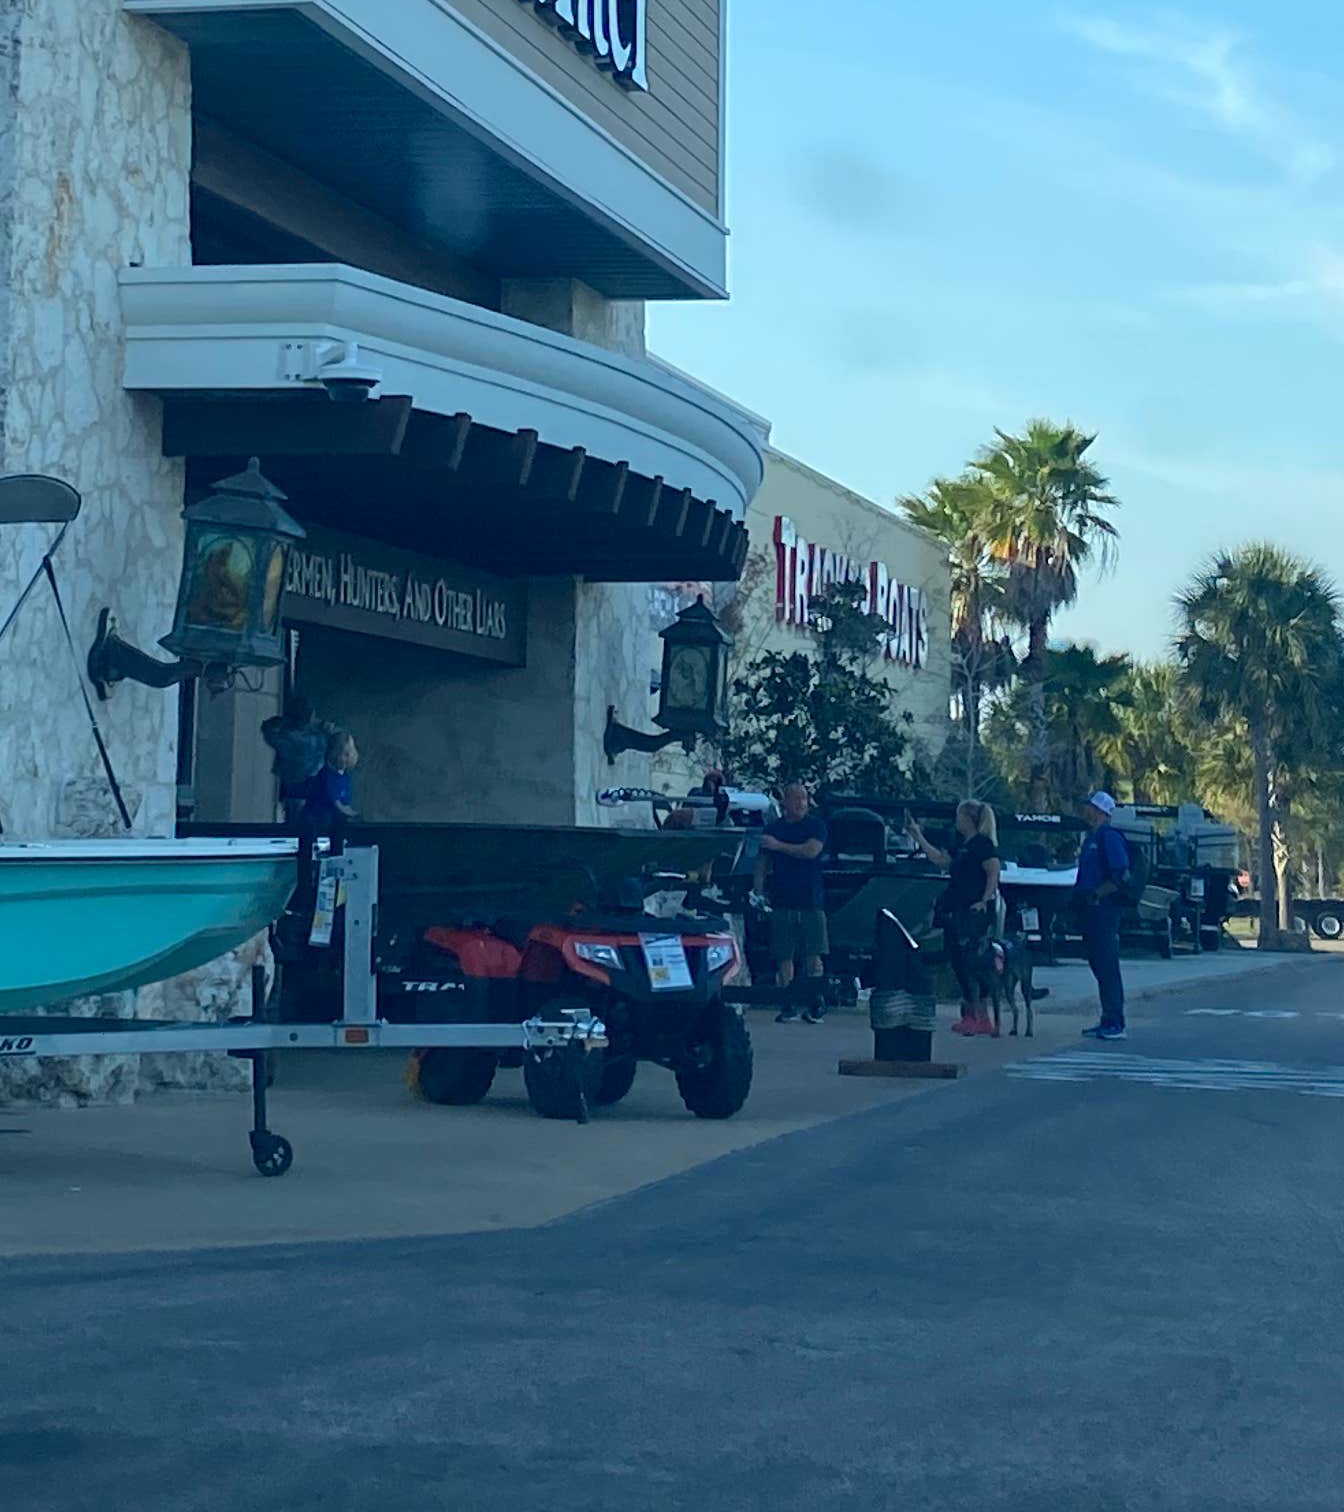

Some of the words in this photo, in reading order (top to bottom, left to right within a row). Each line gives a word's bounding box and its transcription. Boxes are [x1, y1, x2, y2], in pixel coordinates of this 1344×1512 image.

[403, 571, 432, 623] AND
[434, 578, 474, 633] OTHER
[1015, 813, 1061, 824] TAHOE
